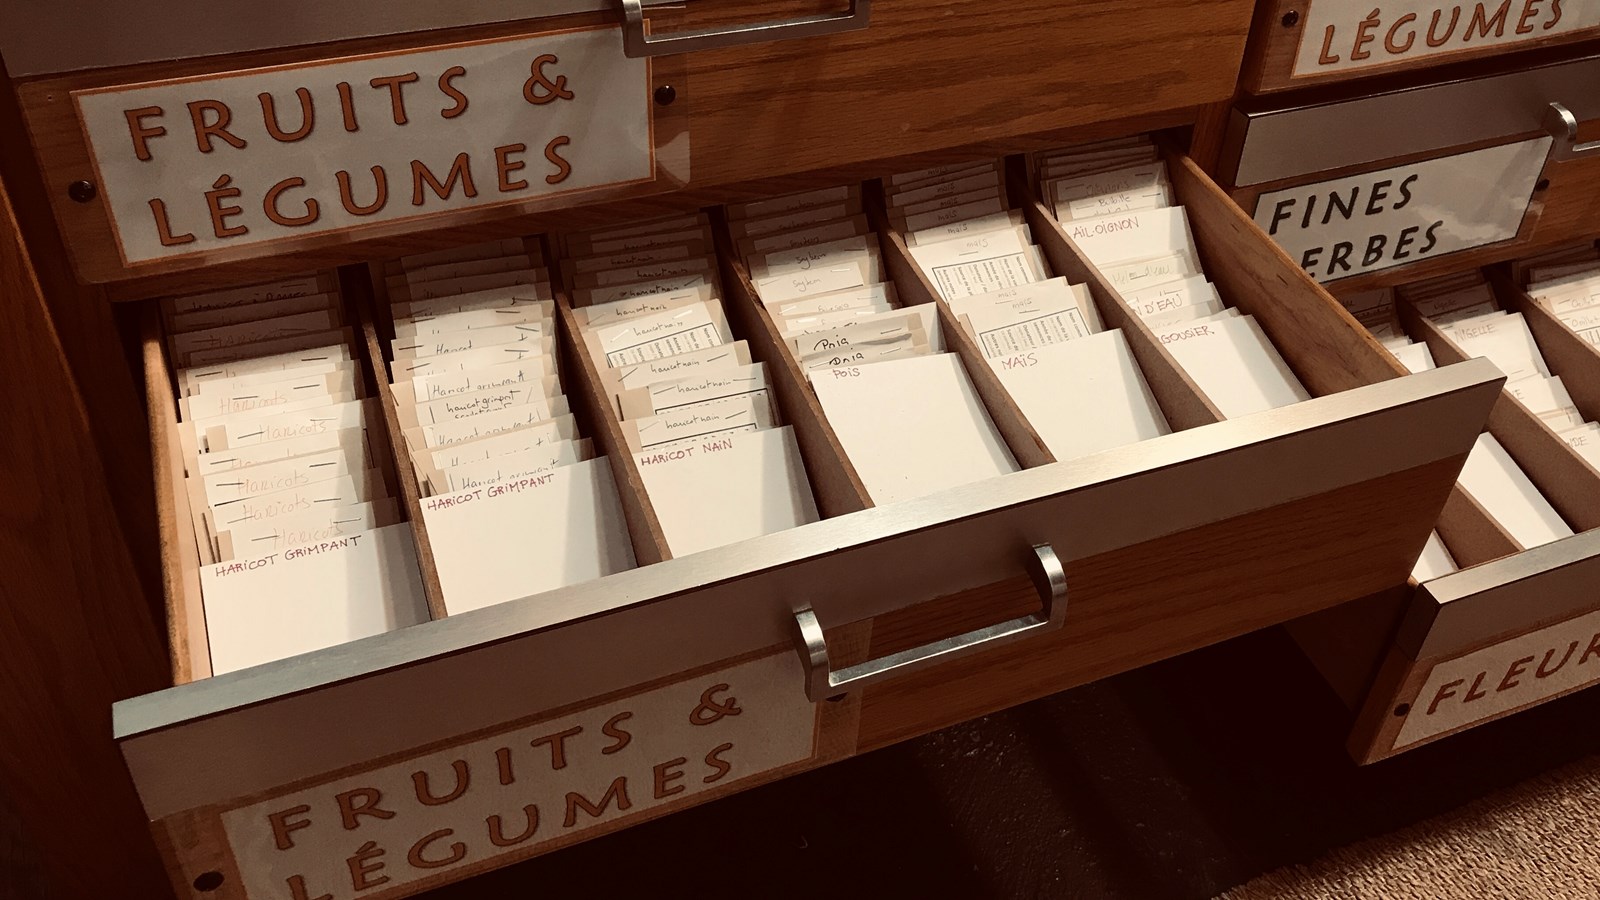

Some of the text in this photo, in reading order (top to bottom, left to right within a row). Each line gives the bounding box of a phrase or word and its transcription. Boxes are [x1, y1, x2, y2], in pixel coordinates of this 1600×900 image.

[1318, 0, 1562, 65] LÉGUMES
[123, 54, 574, 161] FRUITS &
[149, 135, 573, 248] LÉGUMES
[1269, 174, 1418, 235] FINES
[641, 447, 694, 466] HARICOT
[703, 438, 733, 453] NAIN
[427, 474, 554, 511] HARICOT GRIMPANT
[216, 535, 361, 577] HARICOT GRIMPANT
[268, 683, 742, 850] FRUITS &
[286, 742, 733, 900] LÉGUMES
